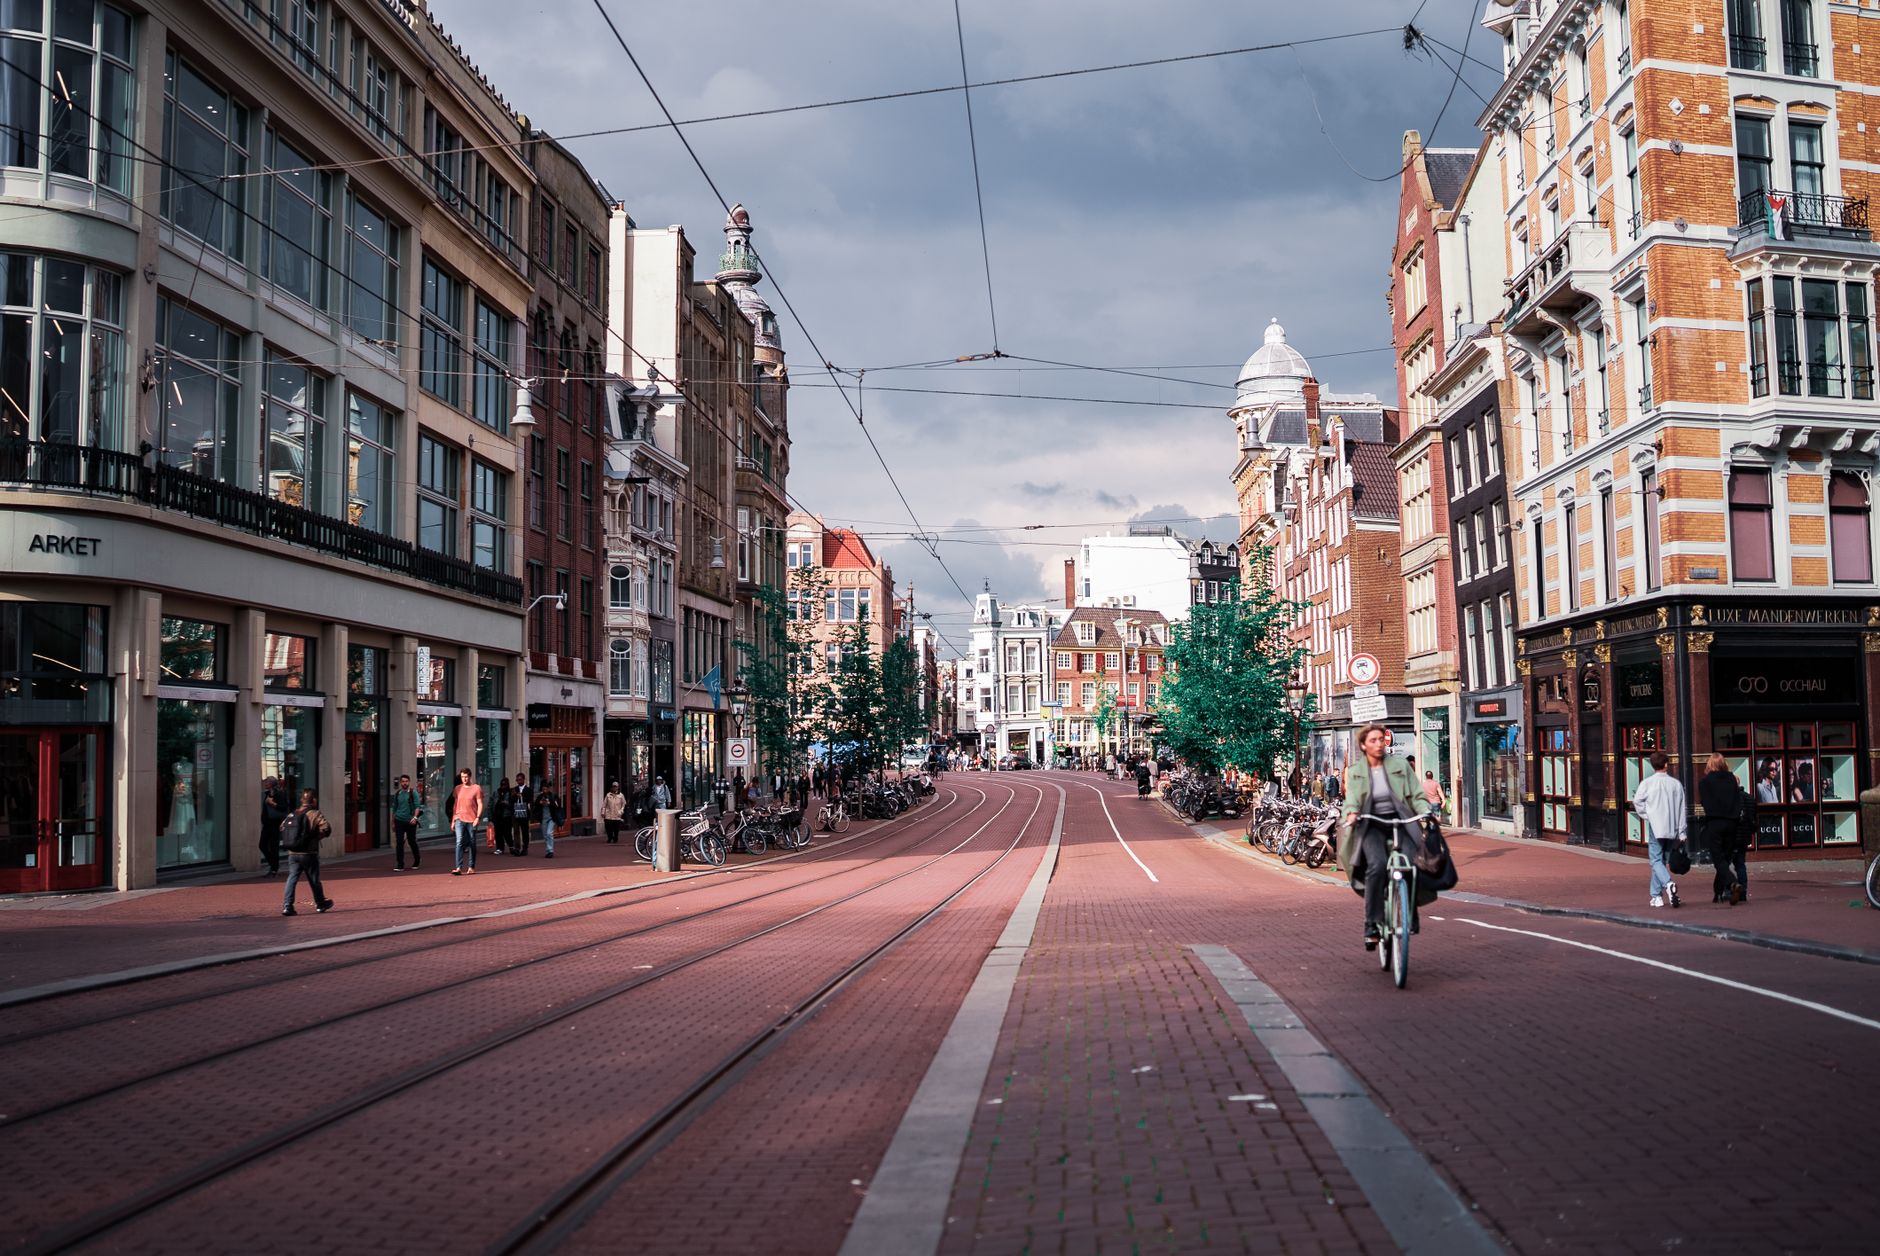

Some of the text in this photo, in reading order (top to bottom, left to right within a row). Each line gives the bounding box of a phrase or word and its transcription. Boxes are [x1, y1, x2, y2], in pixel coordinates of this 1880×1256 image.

[28, 533, 102, 556] ARKET
[1708, 609, 1858, 623] LUXE MANDENWERKEN
[490, 722, 498, 768] RKET
[1793, 824, 1813, 832] UCCI
